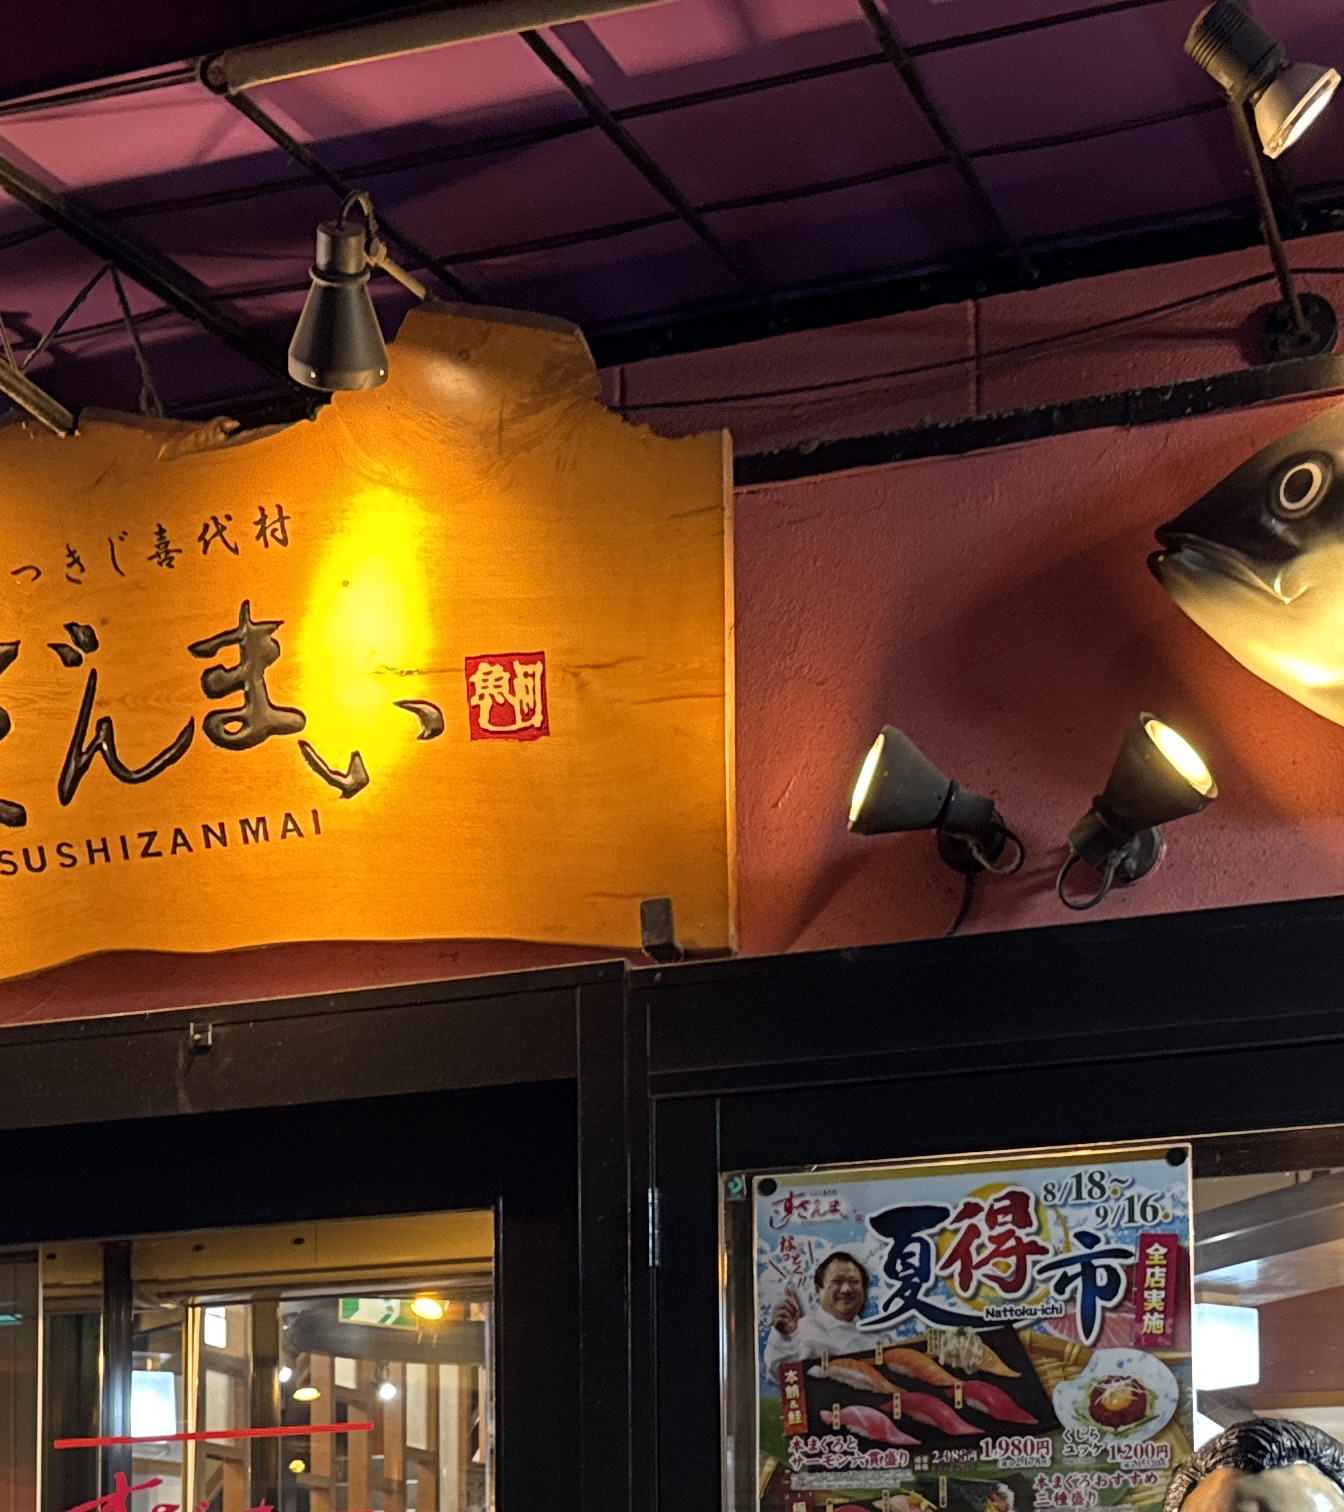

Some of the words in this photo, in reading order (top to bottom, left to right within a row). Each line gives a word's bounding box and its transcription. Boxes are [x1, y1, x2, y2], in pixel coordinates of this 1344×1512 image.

[9, 504, 292, 586] つきじ喜代村
[1143, 1242, 1170, 1336] 全店実施
[985, 1302, 1064, 1321] Nattoku-ichi
[1063, 1427, 1099, 1441] くじら
[789, 1436, 857, 1451] 本まぐろと
[981, 1437, 1051, 1459] 1,980円
[1064, 1444, 1104, 1456] ユッケ
[1108, 1443, 1169, 1461] 1,200円
[790, 1450, 909, 1469] サーモン六貫盛り
[1035, 1473, 1158, 1489] 本まぐろおすすめ
[1034, 1491, 1097, 1506] 三種盛り
